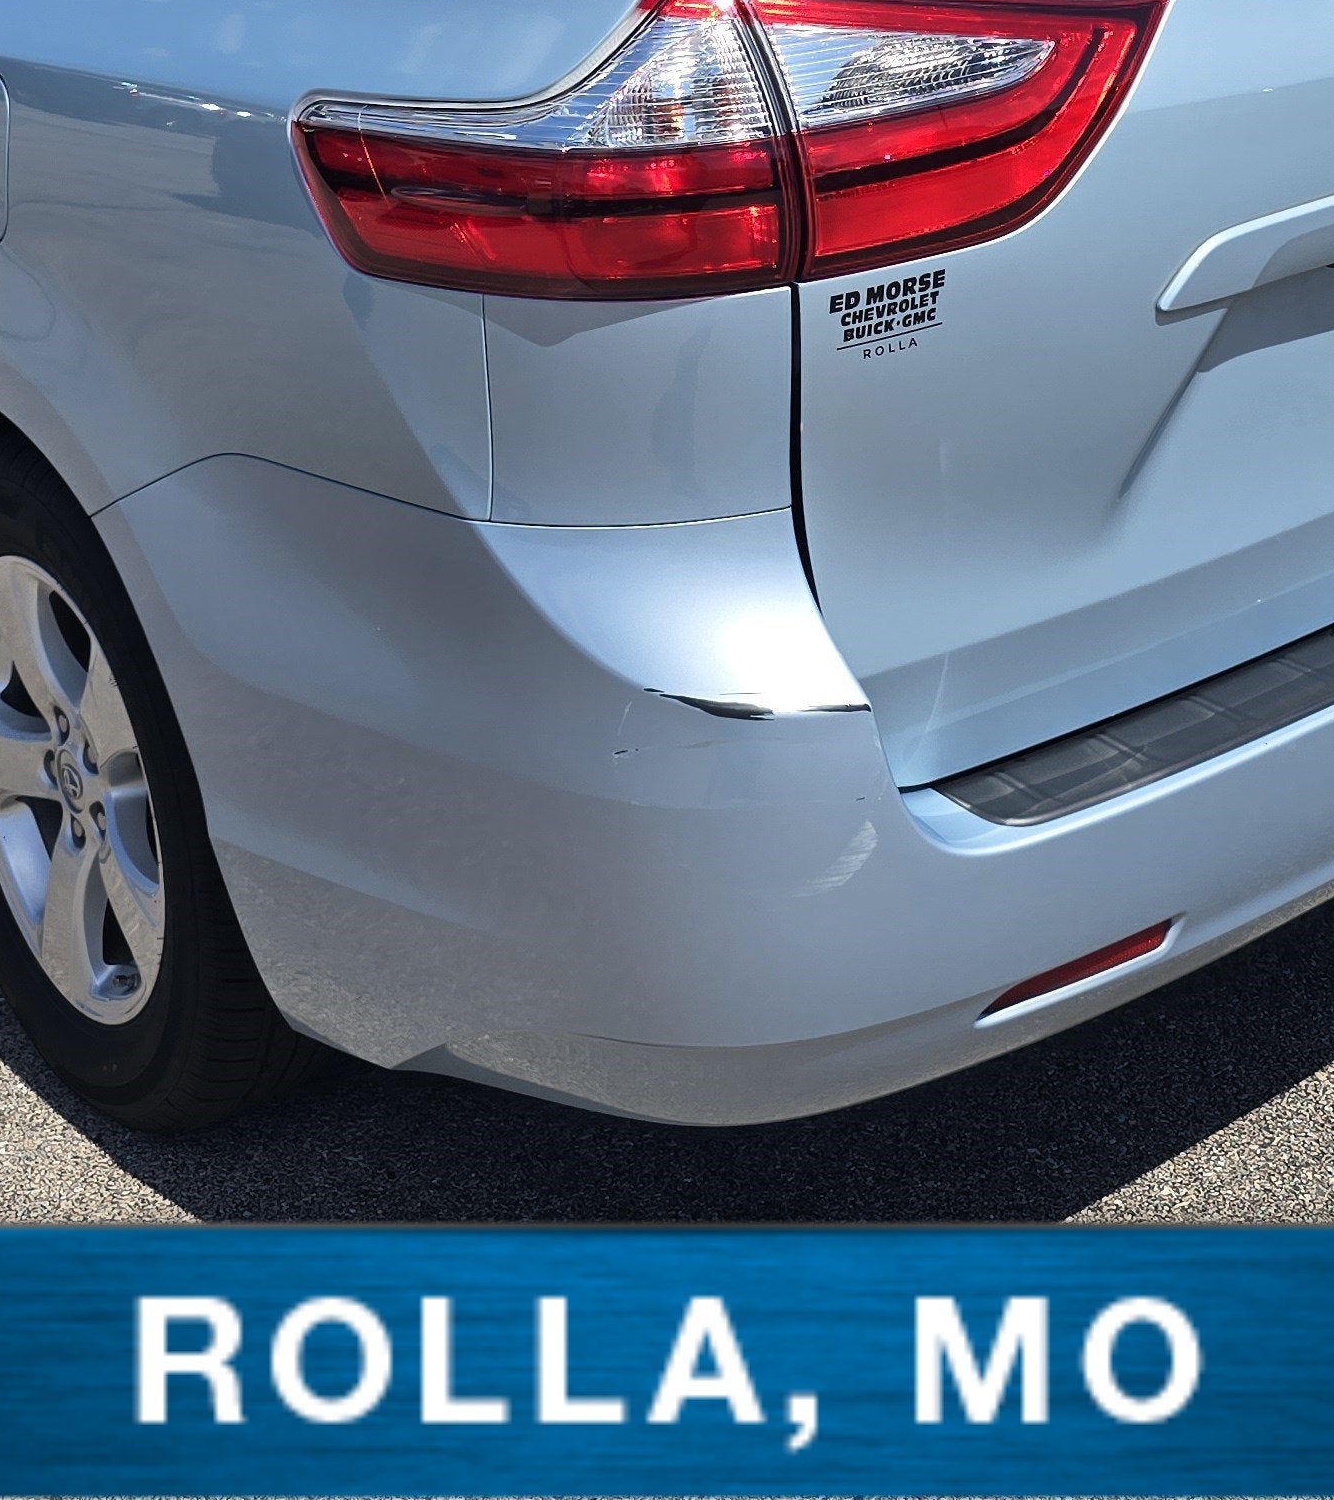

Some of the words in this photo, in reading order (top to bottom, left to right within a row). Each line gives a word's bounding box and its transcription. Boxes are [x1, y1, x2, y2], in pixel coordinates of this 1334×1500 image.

[829, 291, 861, 314] ED
[866, 269, 946, 306] MORSE
[840, 291, 940, 327] CHEVROLET
[863, 337, 918, 360] ROLLA
